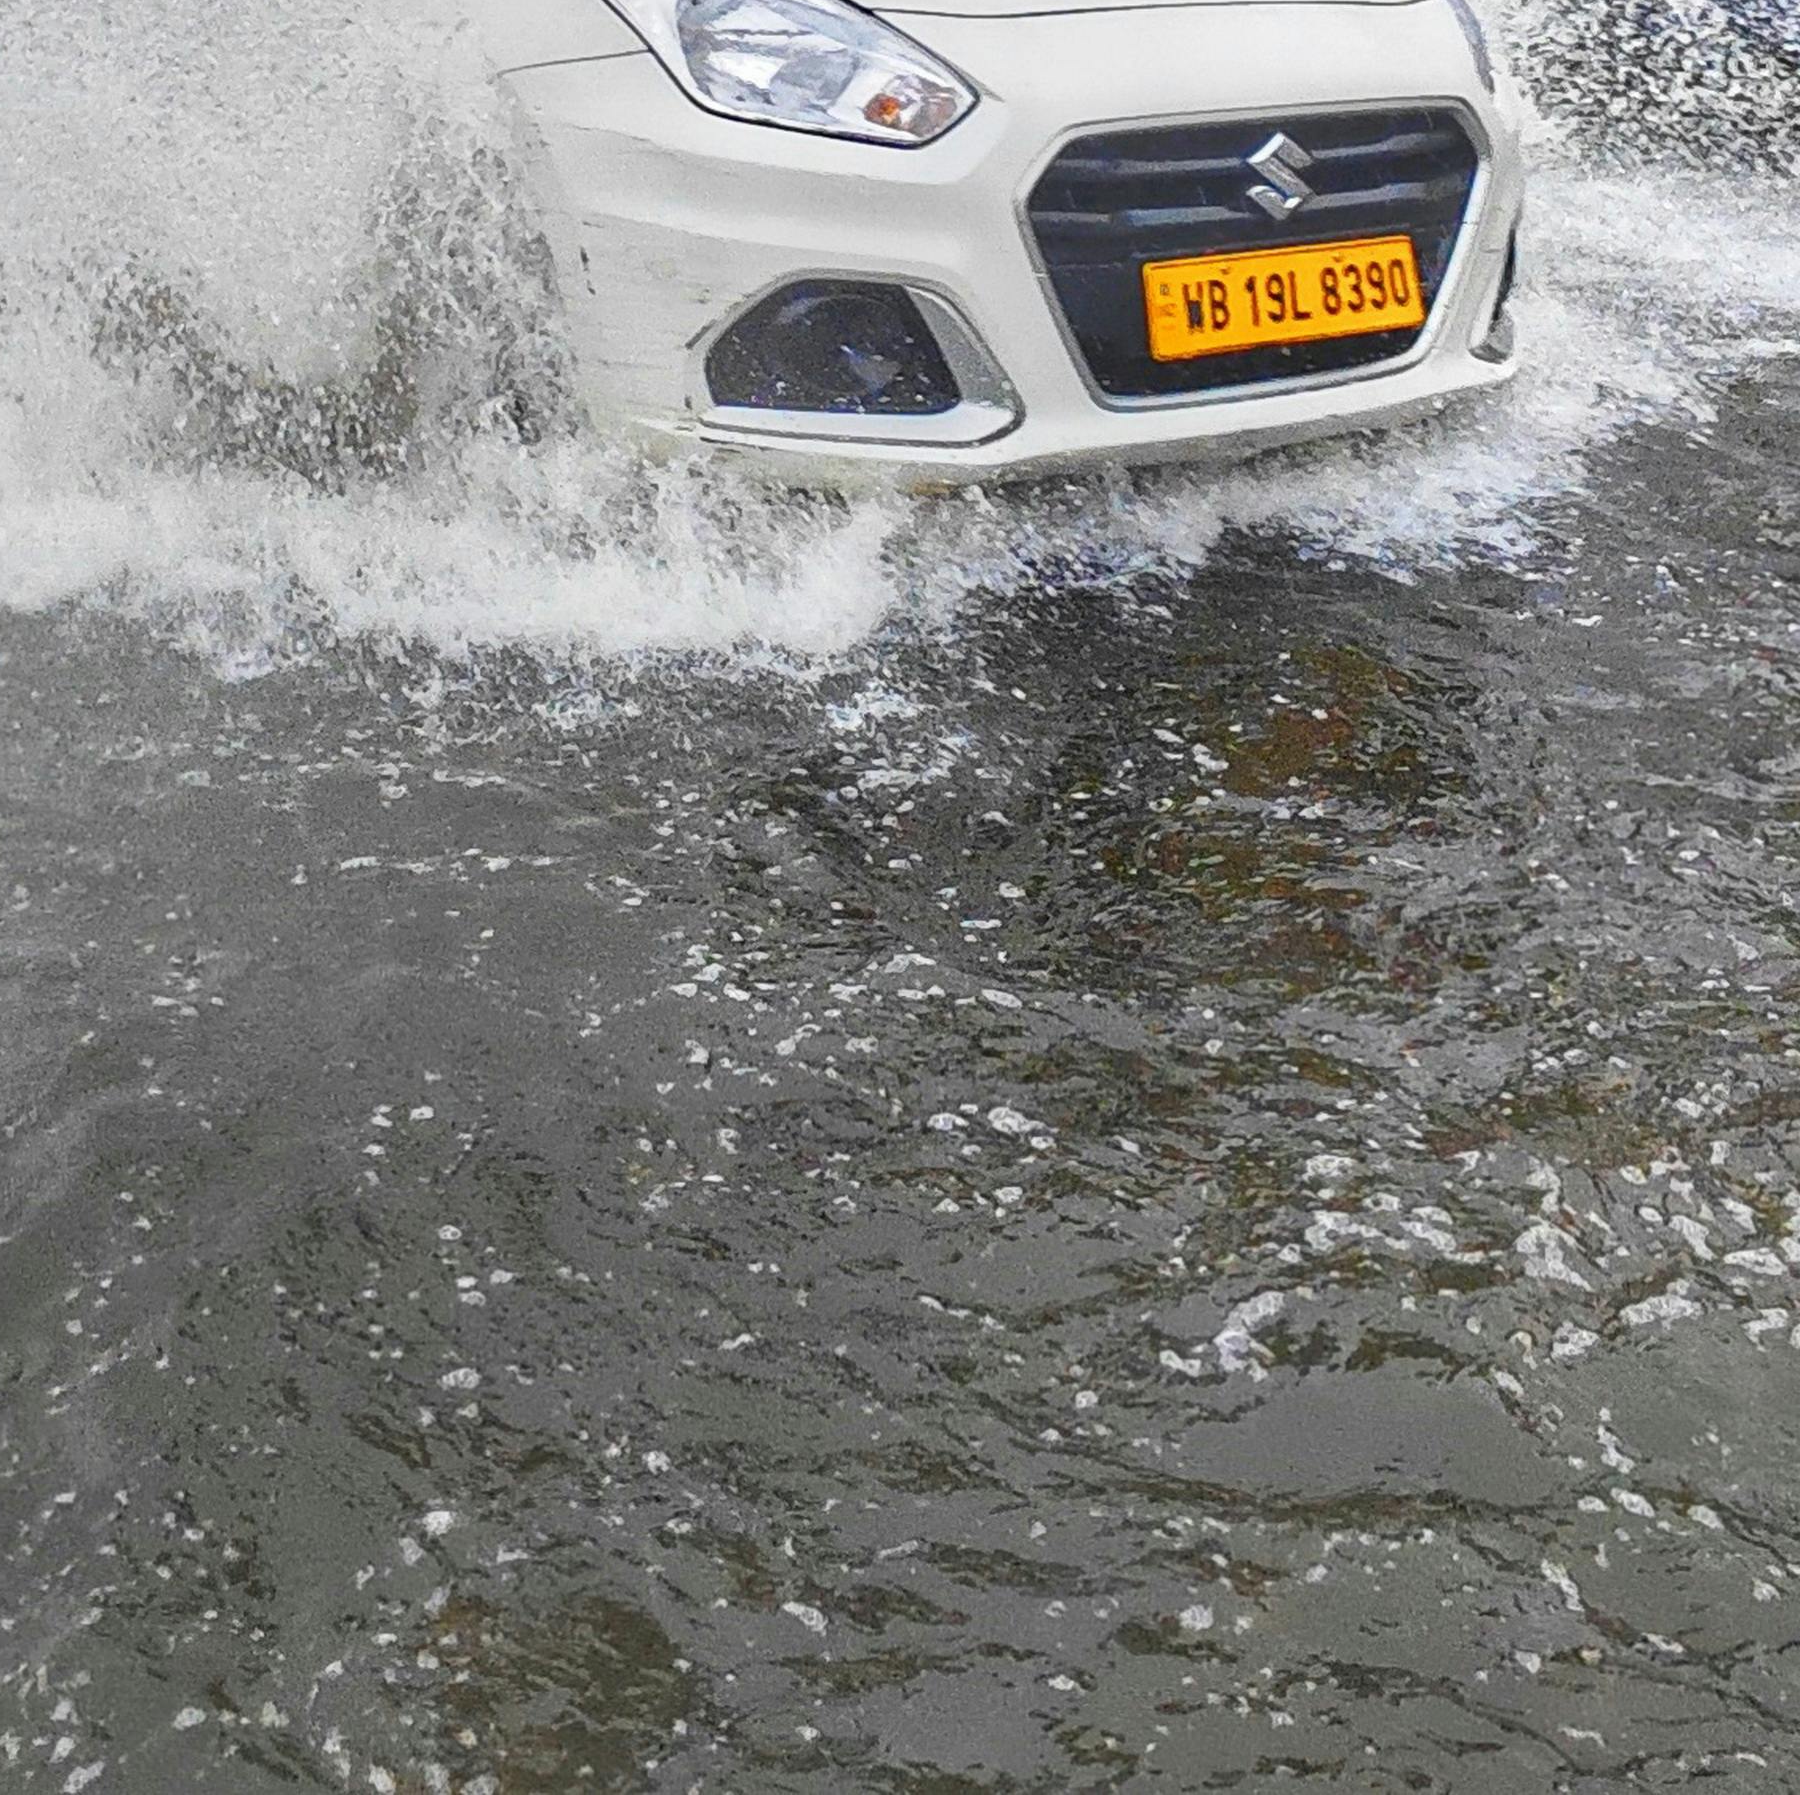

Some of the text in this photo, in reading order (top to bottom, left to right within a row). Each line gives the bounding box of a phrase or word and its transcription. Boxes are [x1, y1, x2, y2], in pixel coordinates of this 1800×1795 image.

[1182, 280, 1231, 332] WB
[1246, 269, 1312, 327] 19L
[1320, 258, 1411, 316] 8390
